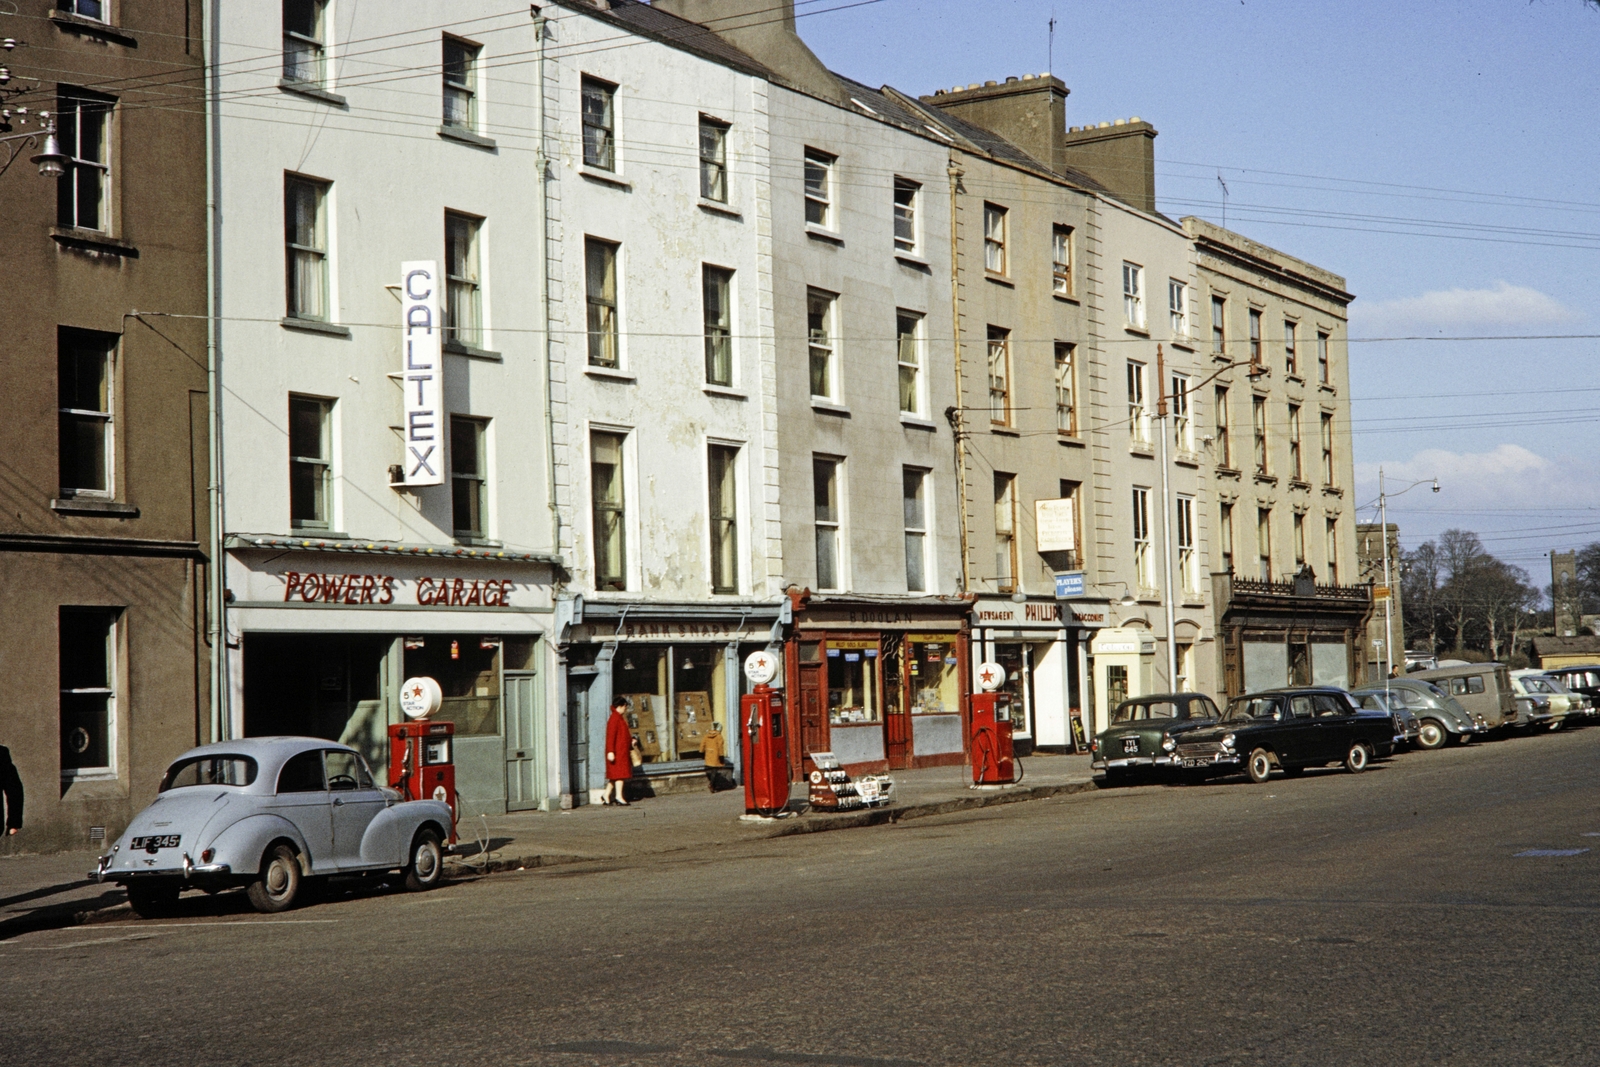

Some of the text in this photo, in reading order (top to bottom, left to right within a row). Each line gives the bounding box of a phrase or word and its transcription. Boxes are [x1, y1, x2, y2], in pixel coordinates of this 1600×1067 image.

[405, 269, 437, 477] CALTEX
[284, 572, 512, 607] POWER'S GARAGE
[862, 611, 912, 623] DOOLAN
[979, 604, 1104, 623] NEWSAGENT PHILLIPS TOBACCONIST
[678, 622, 730, 638] SNAPS
[403, 691, 410, 700] 5
[153, 835, 178, 848] 345
